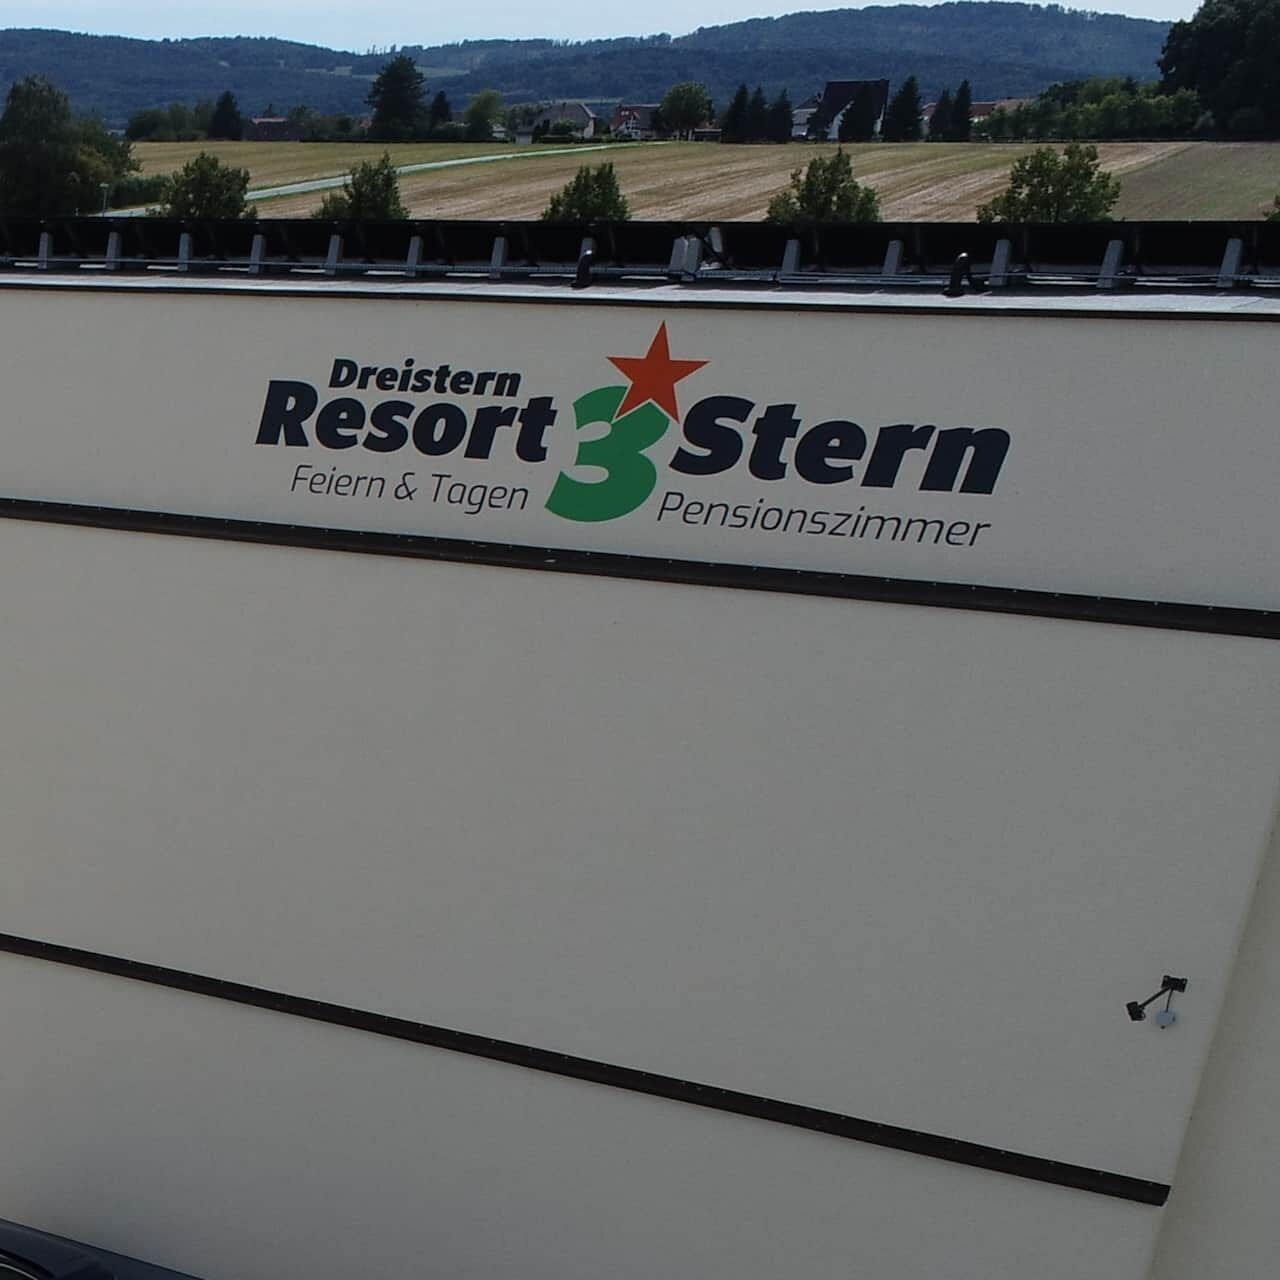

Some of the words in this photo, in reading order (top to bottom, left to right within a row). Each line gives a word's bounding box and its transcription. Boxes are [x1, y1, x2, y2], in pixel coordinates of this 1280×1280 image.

[328, 357, 523, 398] Dreistern
[254, 378, 559, 463] Resort
[544, 384, 670, 523] 3
[667, 395, 1012, 496] Stern
[290, 464, 386, 499] Feiern
[393, 471, 418, 502] &
[430, 473, 530, 516] Tagen
[655, 491, 993, 547] Pensionszimmer
